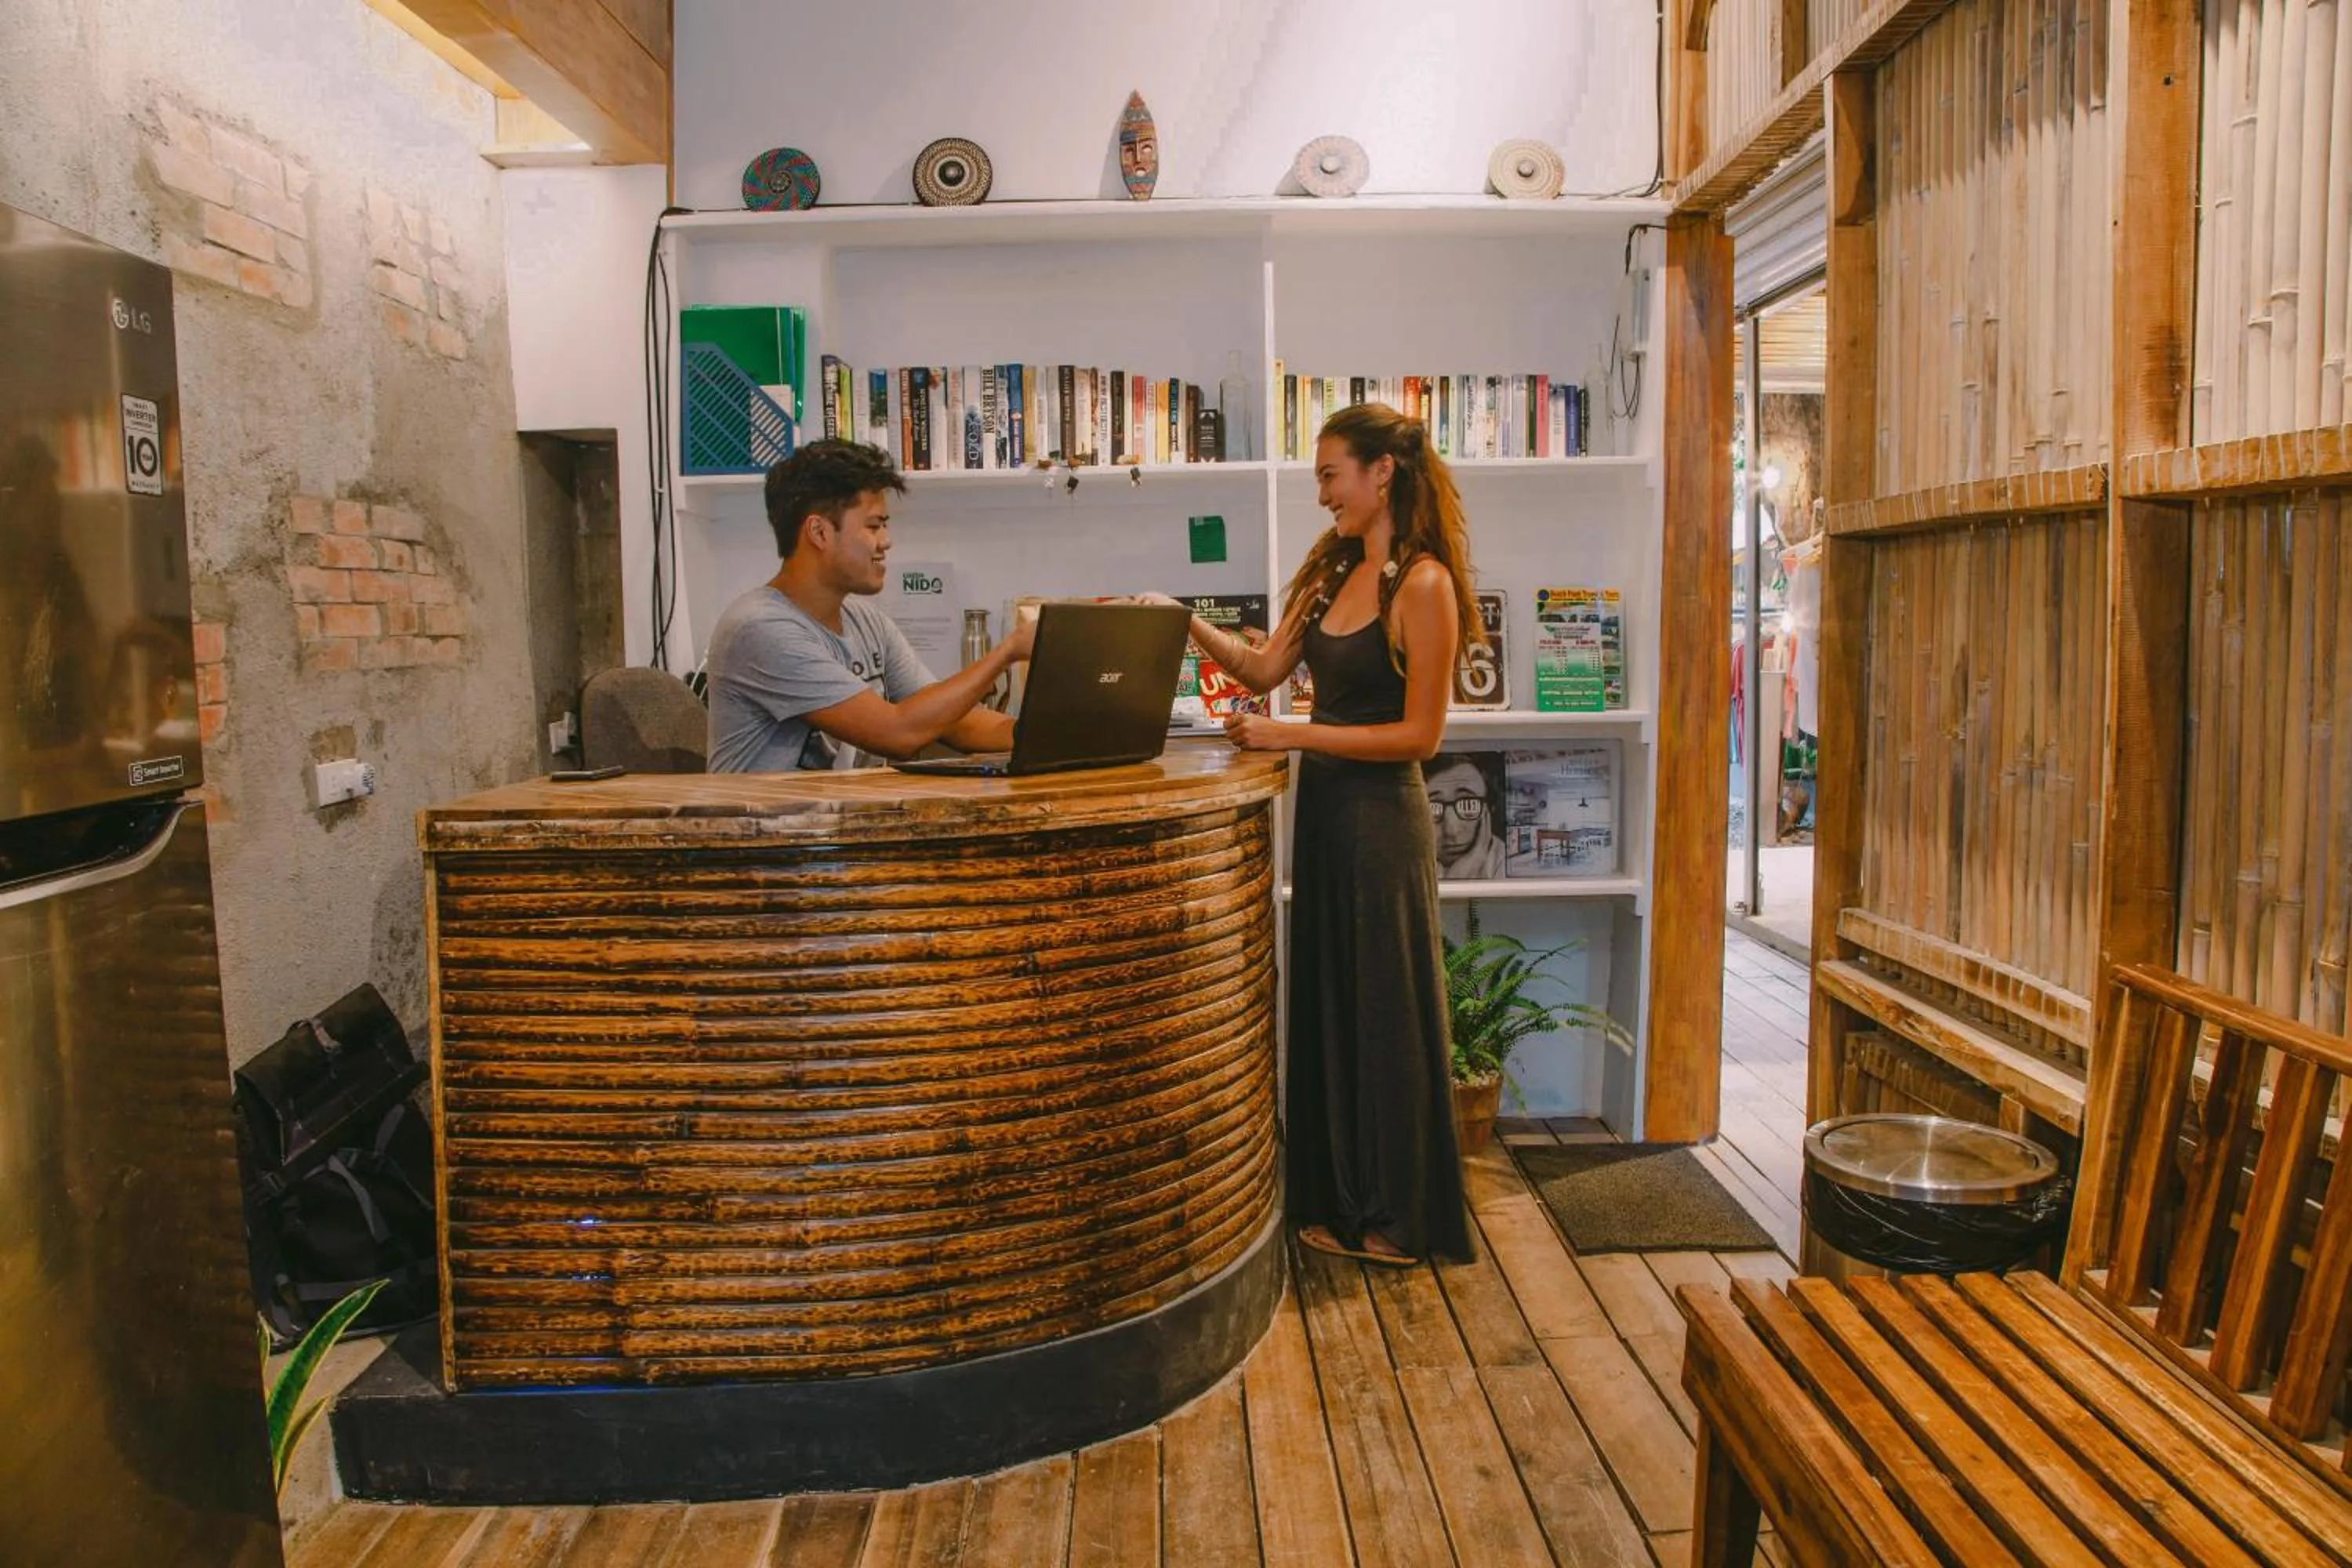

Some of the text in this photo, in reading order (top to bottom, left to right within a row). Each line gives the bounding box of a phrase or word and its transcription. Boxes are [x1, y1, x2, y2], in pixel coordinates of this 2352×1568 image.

[983, 368, 995, 434] BILL BRYSON
[128, 435, 158, 477] 10
[1194, 598, 1215, 608] 101
[1099, 673, 1123, 683] acer
[1461, 643, 1496, 696] 6
